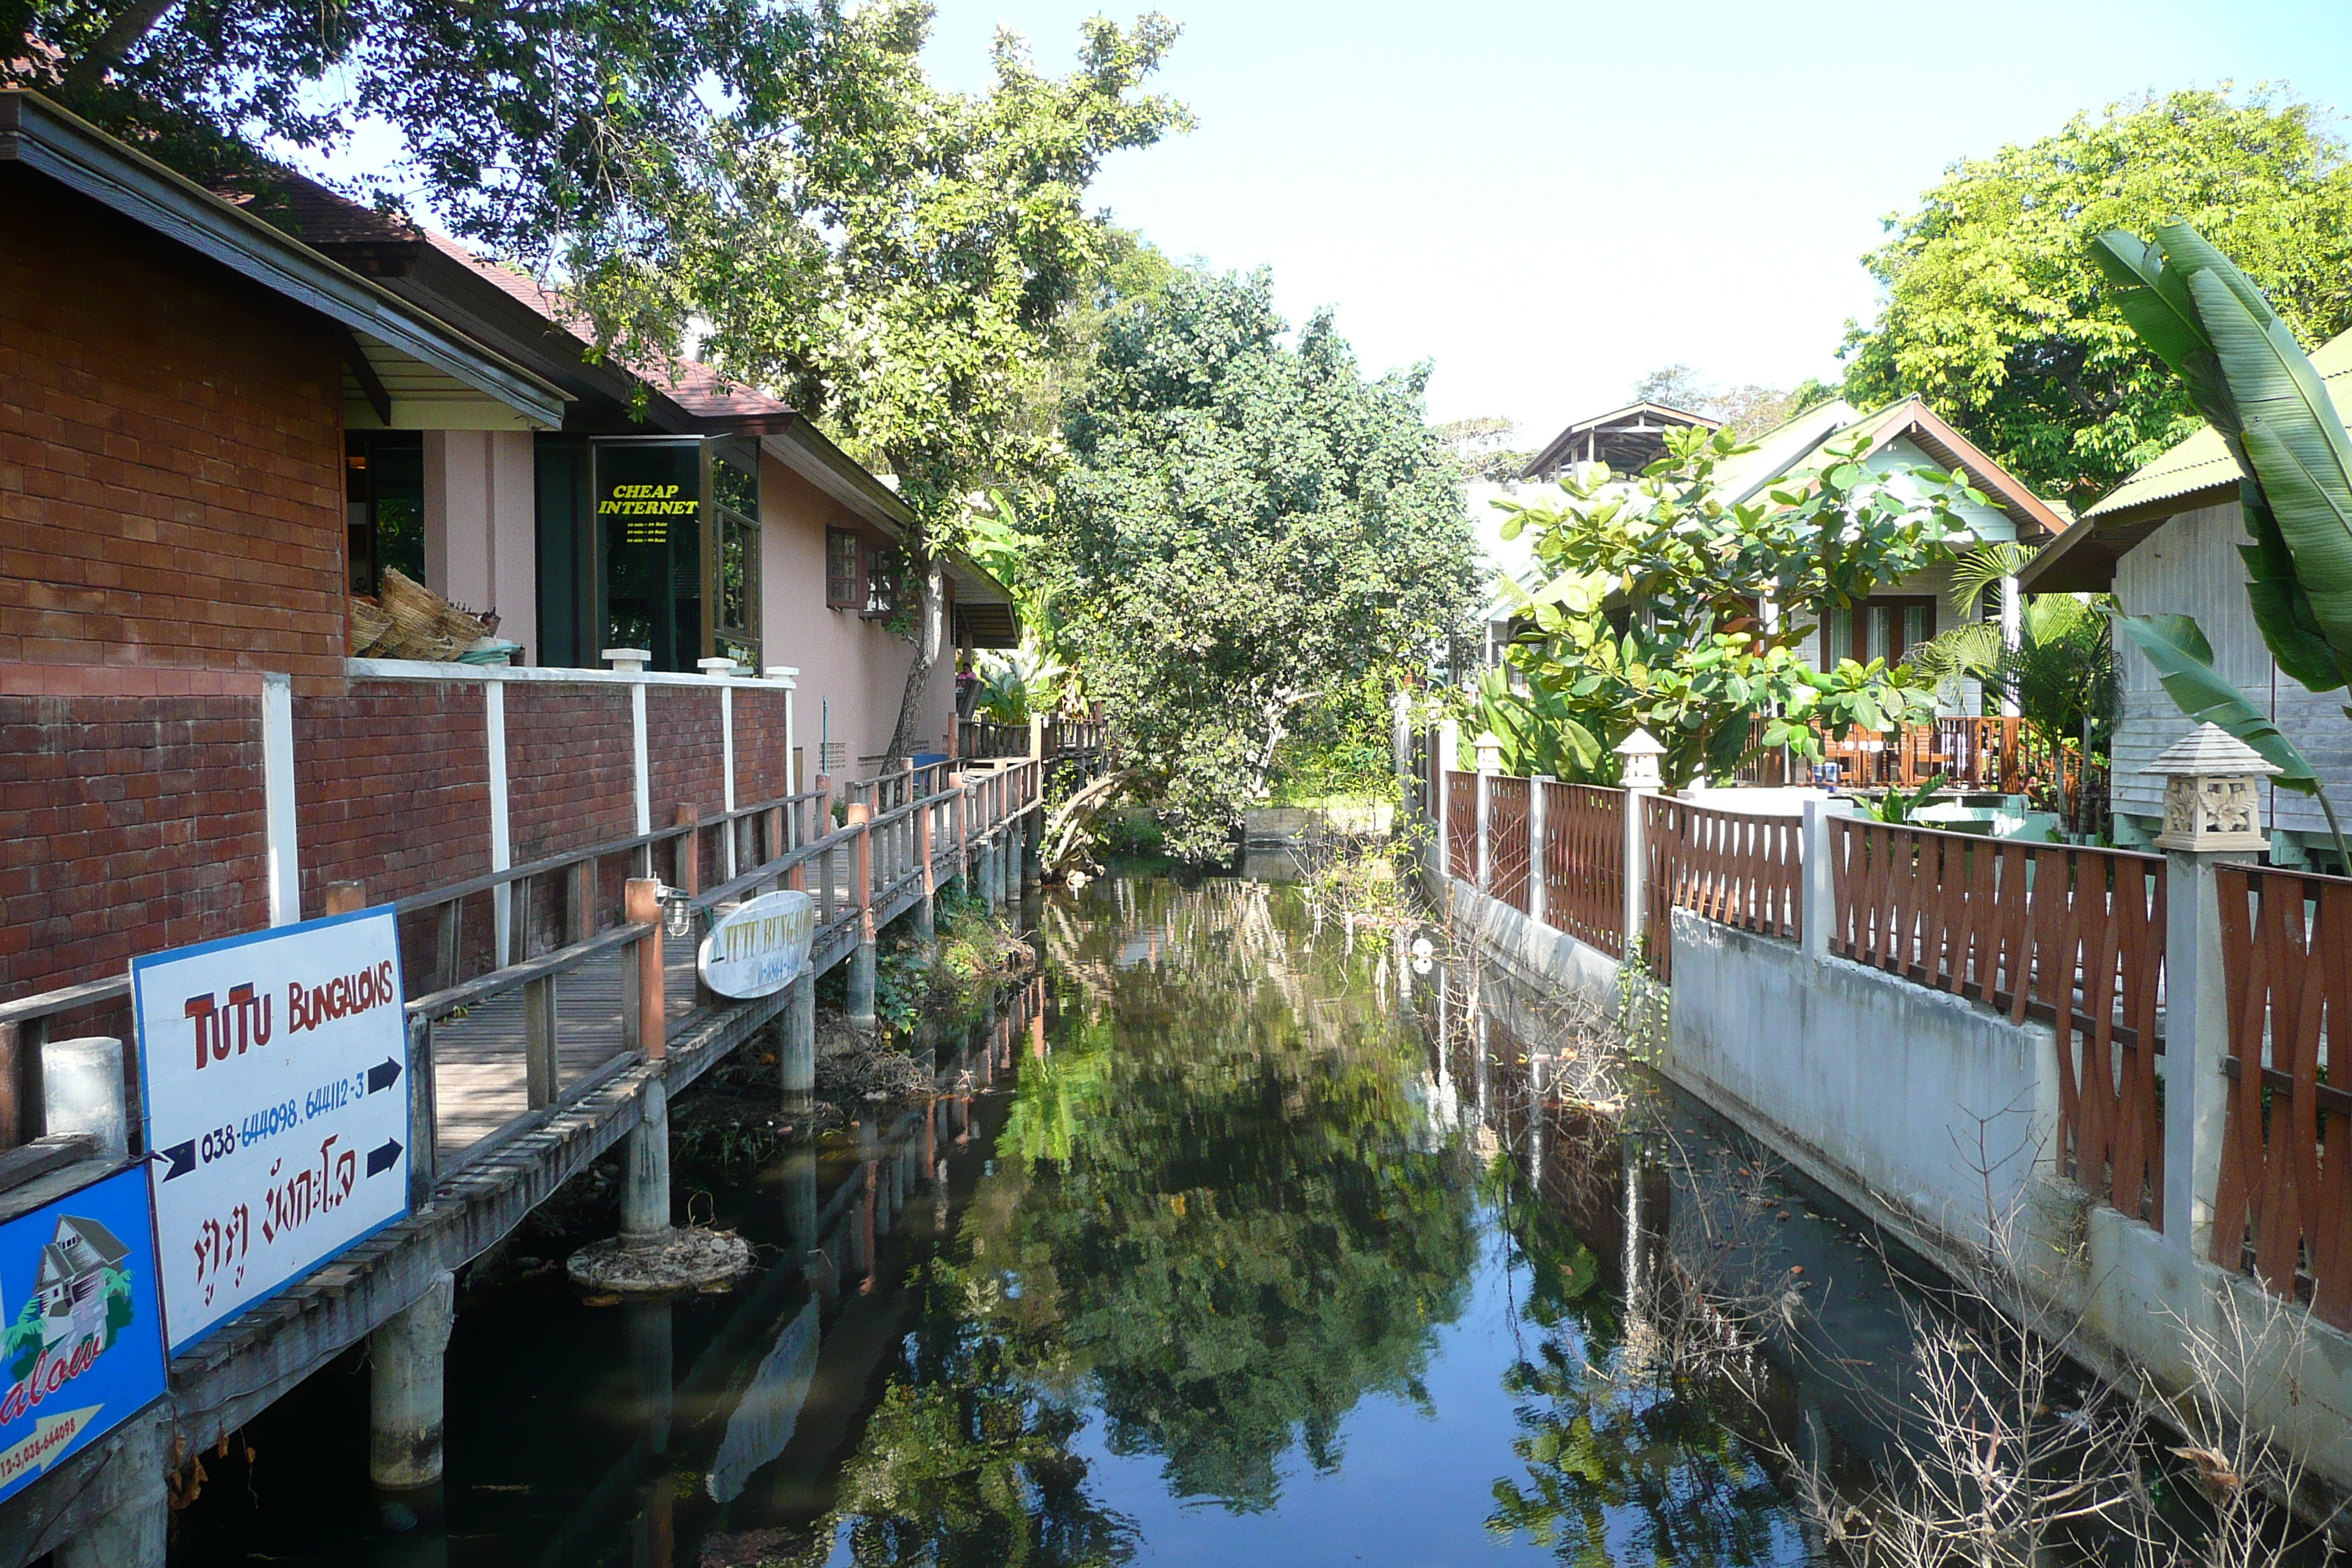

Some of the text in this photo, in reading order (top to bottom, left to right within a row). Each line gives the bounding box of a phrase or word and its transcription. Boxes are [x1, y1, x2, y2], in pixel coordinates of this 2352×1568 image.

[598, 501, 698, 515] INTERNET
[613, 485, 679, 499] CHEAP
[725, 919, 759, 964] TUTU
[184, 960, 393, 1070] TUTU BUNGALOWS
[306, 1071, 364, 1120] 644112-3
[194, 1202, 249, 1308] ตูตู
